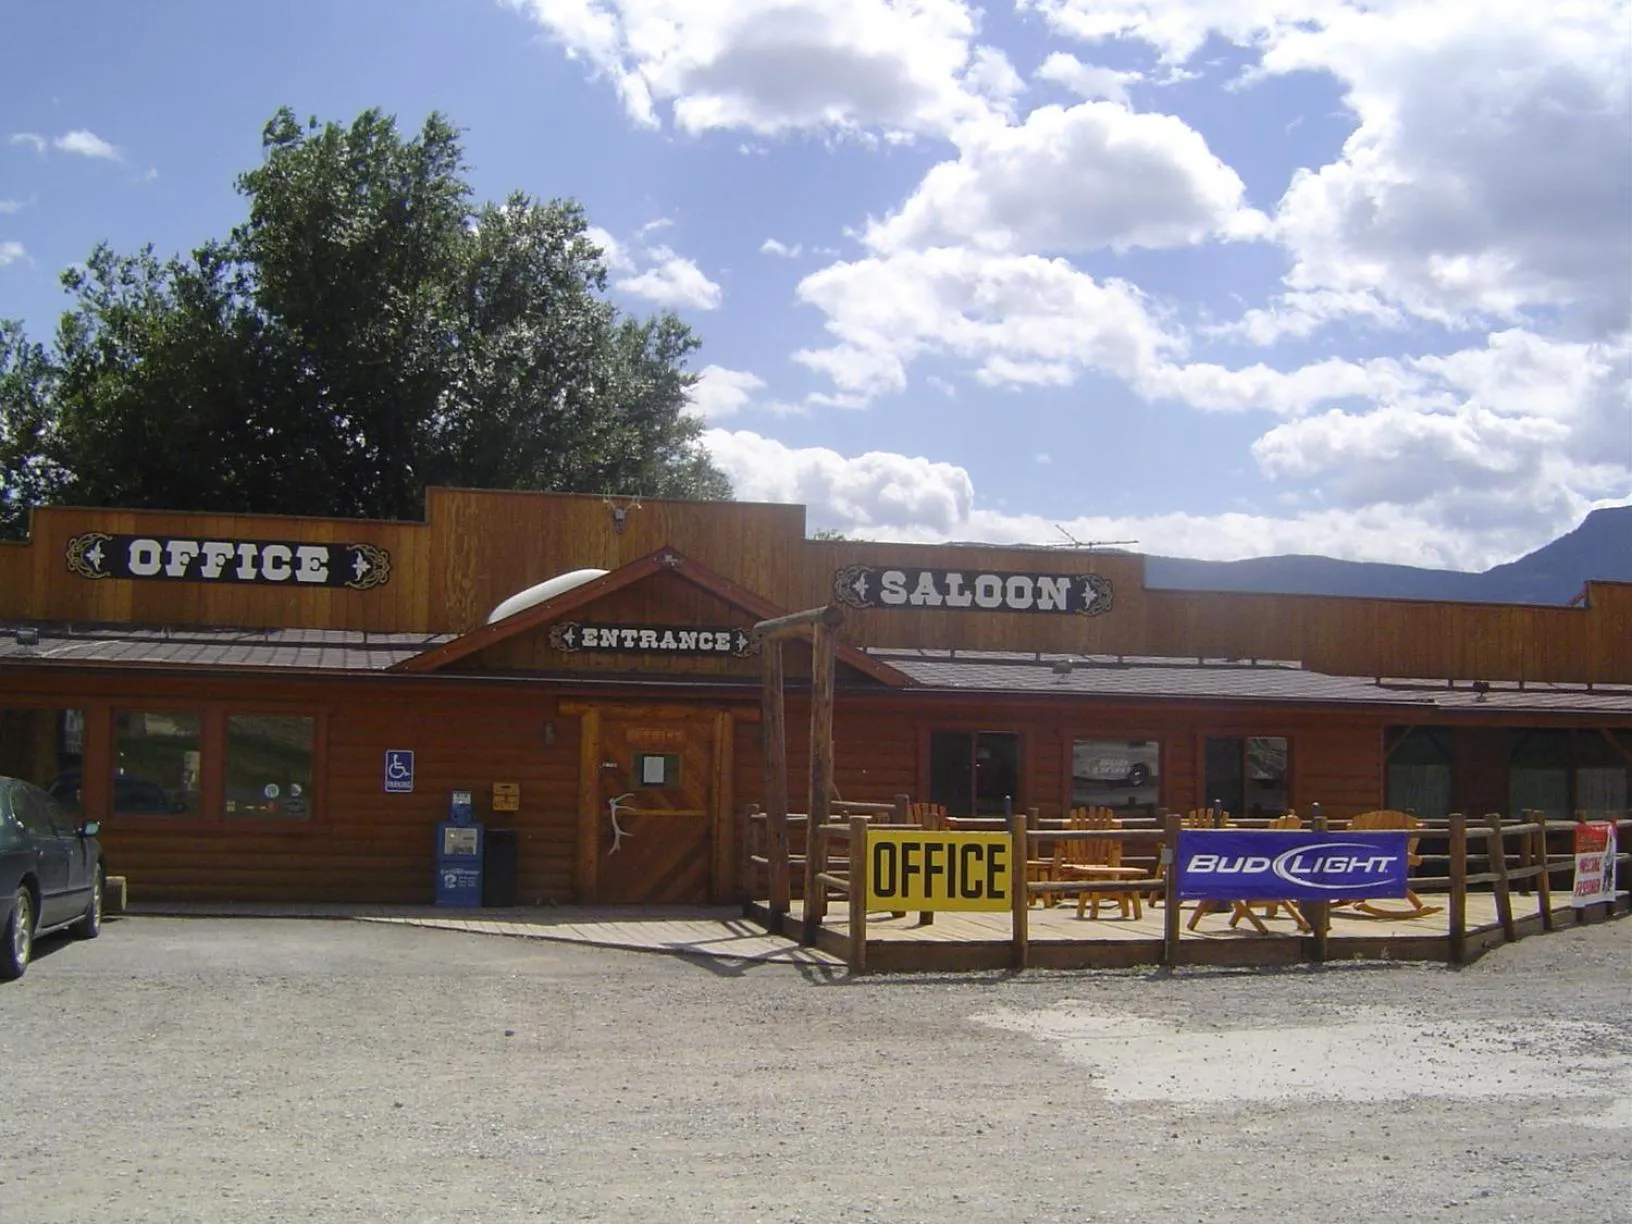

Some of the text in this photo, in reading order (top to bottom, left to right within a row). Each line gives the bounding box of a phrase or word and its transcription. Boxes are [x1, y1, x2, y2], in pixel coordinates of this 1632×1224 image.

[128, 539, 330, 582] OFFICE
[880, 570, 1072, 610] SALOON
[581, 628, 731, 650] ENTRANCE
[873, 842, 1006, 898] OFFICE
[1186, 854, 1398, 874] BUD LIGHT
